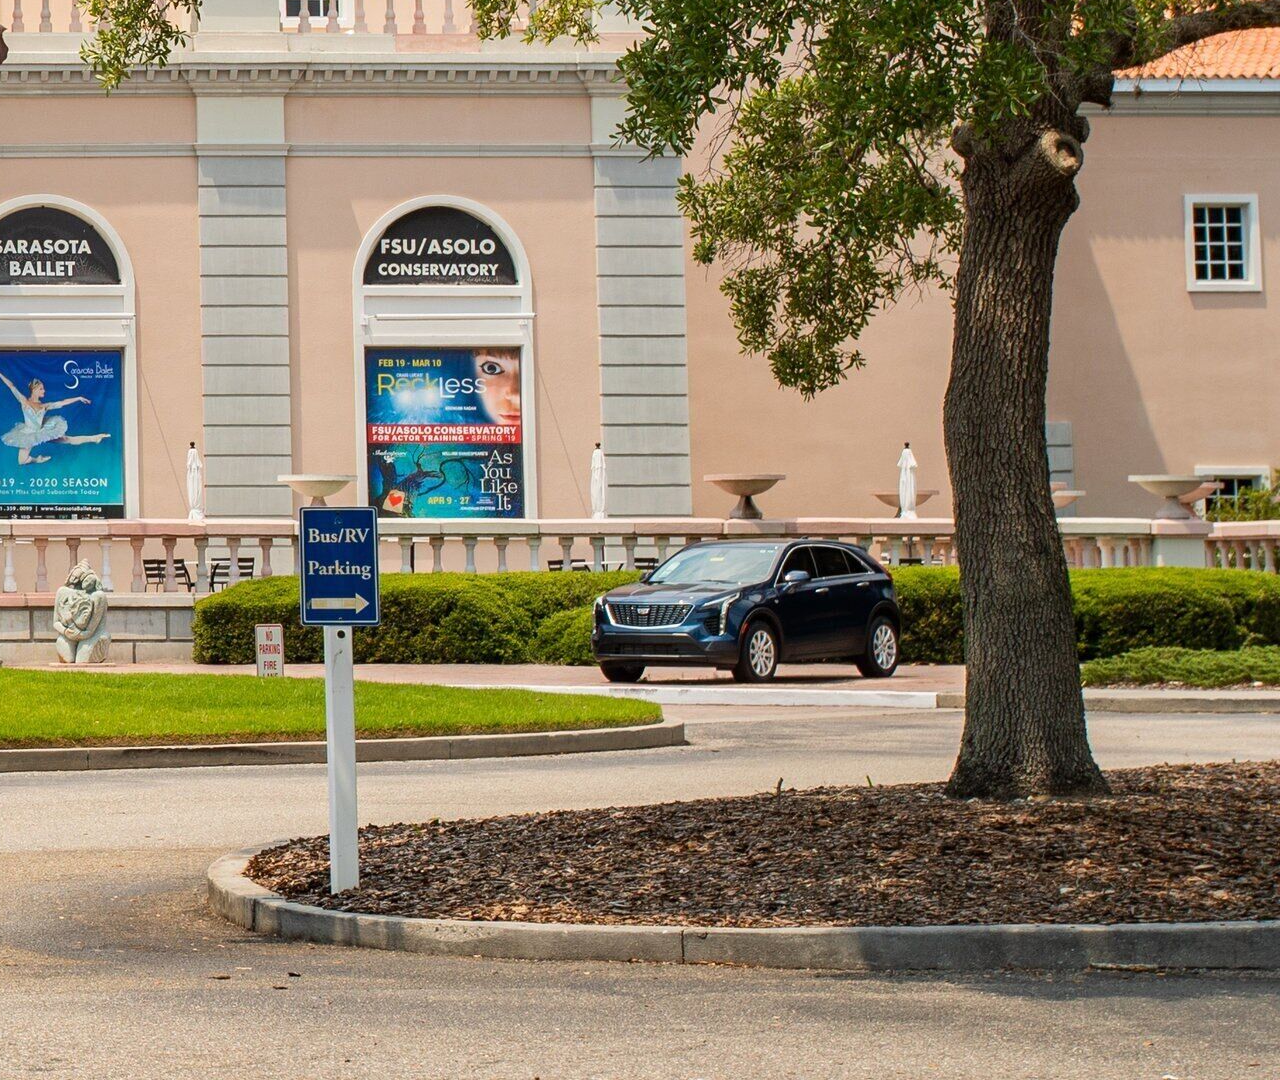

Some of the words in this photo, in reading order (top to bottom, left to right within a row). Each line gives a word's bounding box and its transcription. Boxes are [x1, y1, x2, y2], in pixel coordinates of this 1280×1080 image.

[380, 238, 496, 256] FSU/ASOLO
[9, 261, 76, 277] BALLET
[378, 263, 499, 277] CONSERVATORY
[378, 359, 394, 367] FEB
[396, 359, 405, 367] 19
[412, 359, 430, 367] MAR
[432, 359, 442, 367] 10
[372, 426, 432, 435] FSU/ASOLO
[433, 426, 517, 435] CONSERVATORY
[490, 450, 513, 464] As
[480, 464, 511, 479] You
[29, 478, 58, 487] 2020
[62, 478, 108, 487] SEASON
[480, 479, 518, 493] Like
[428, 497, 445, 505] APR
[446, 497, 452, 505] 9
[459, 497, 470, 505] 27
[497, 494, 512, 511] It
[308, 528, 370, 544] Bus/RV
[308, 560, 372, 580] Parking
[265, 631, 273, 641] NO
[259, 643, 281, 654] PARKING
[263, 660, 277, 670] FIRE
